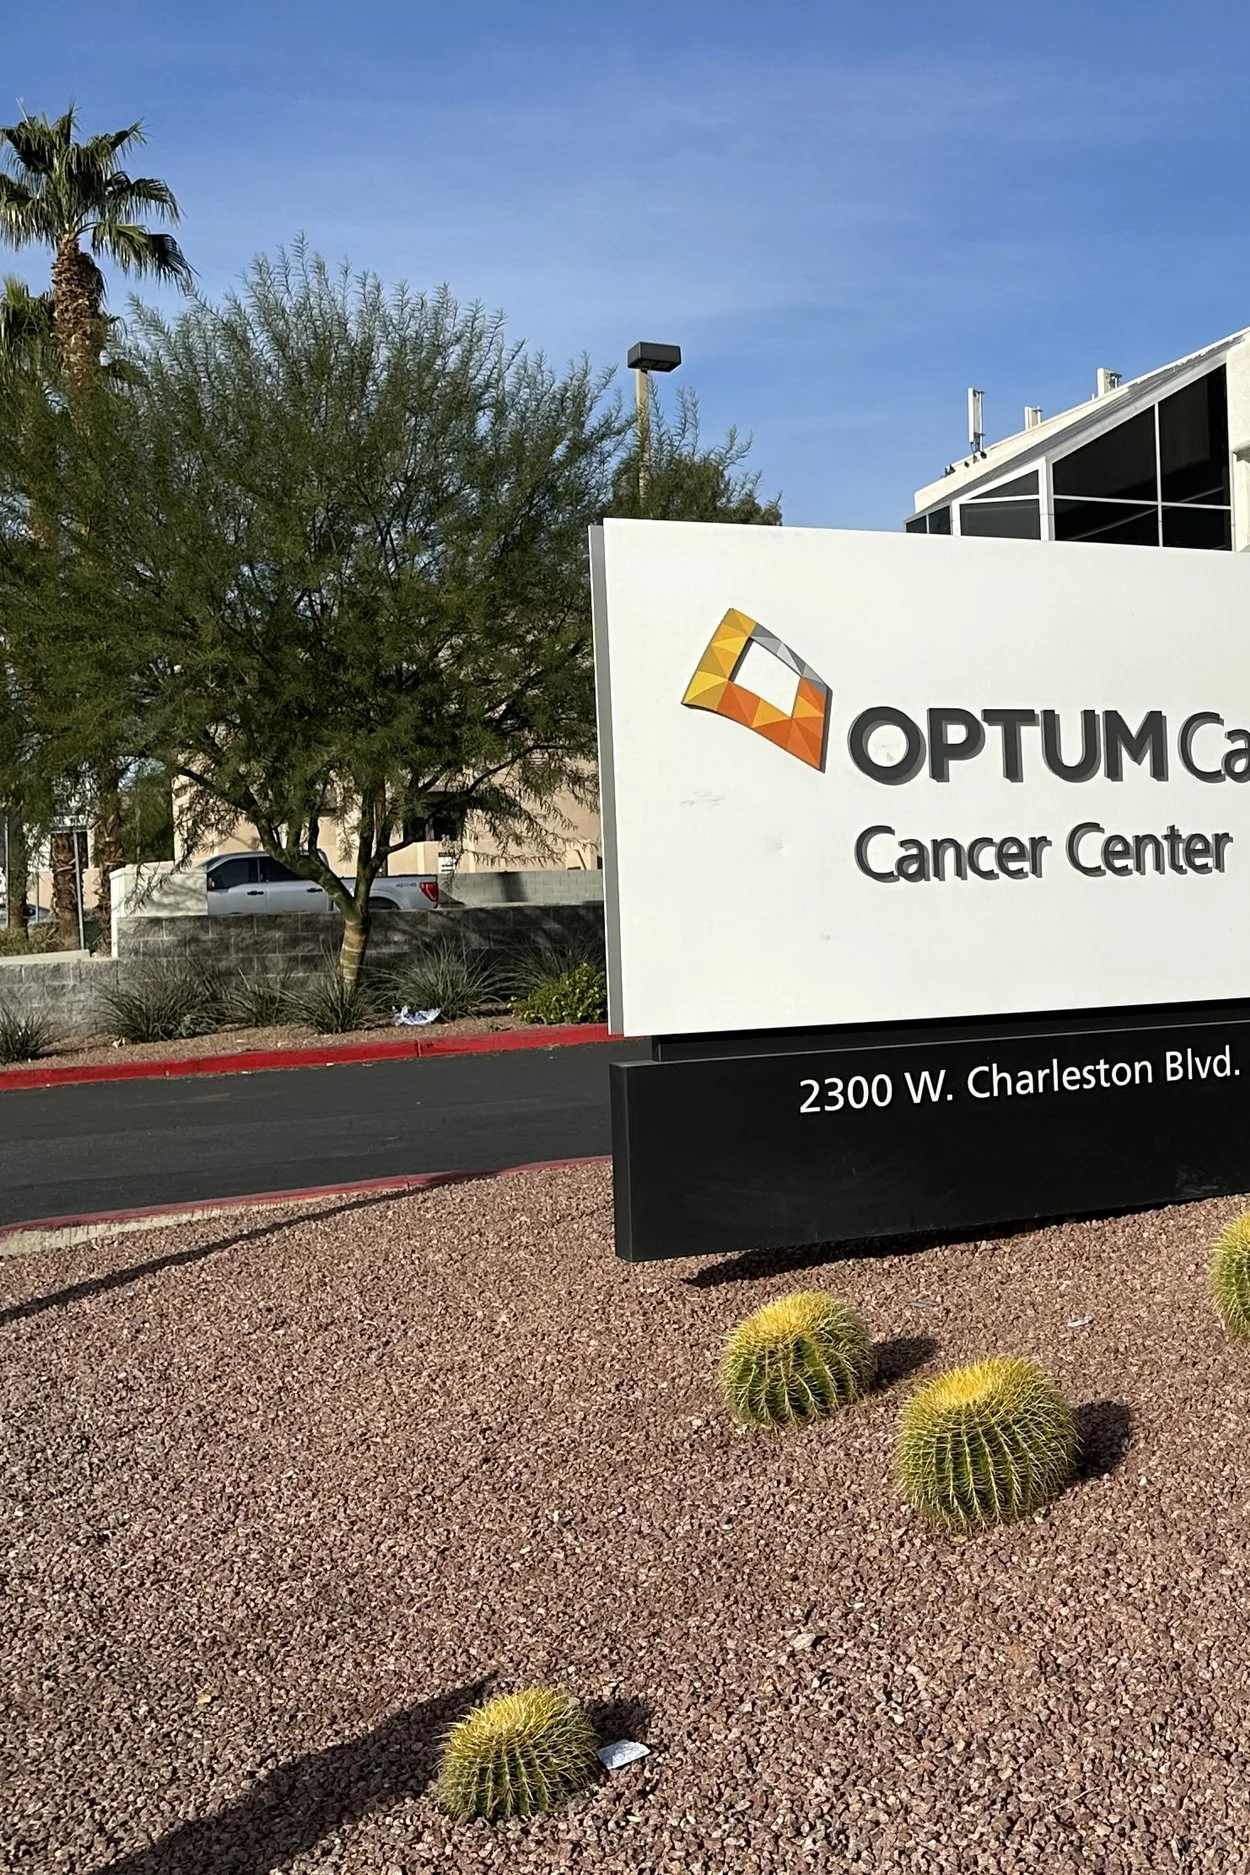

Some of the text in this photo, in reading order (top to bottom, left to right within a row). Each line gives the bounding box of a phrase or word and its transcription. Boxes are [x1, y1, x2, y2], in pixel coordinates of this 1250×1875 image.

[847, 706, 1169, 785] OPTUM
[855, 822, 1234, 883] Cancer Center
[799, 1045, 1240, 1114] 2300 W. Charleston Blvd.
